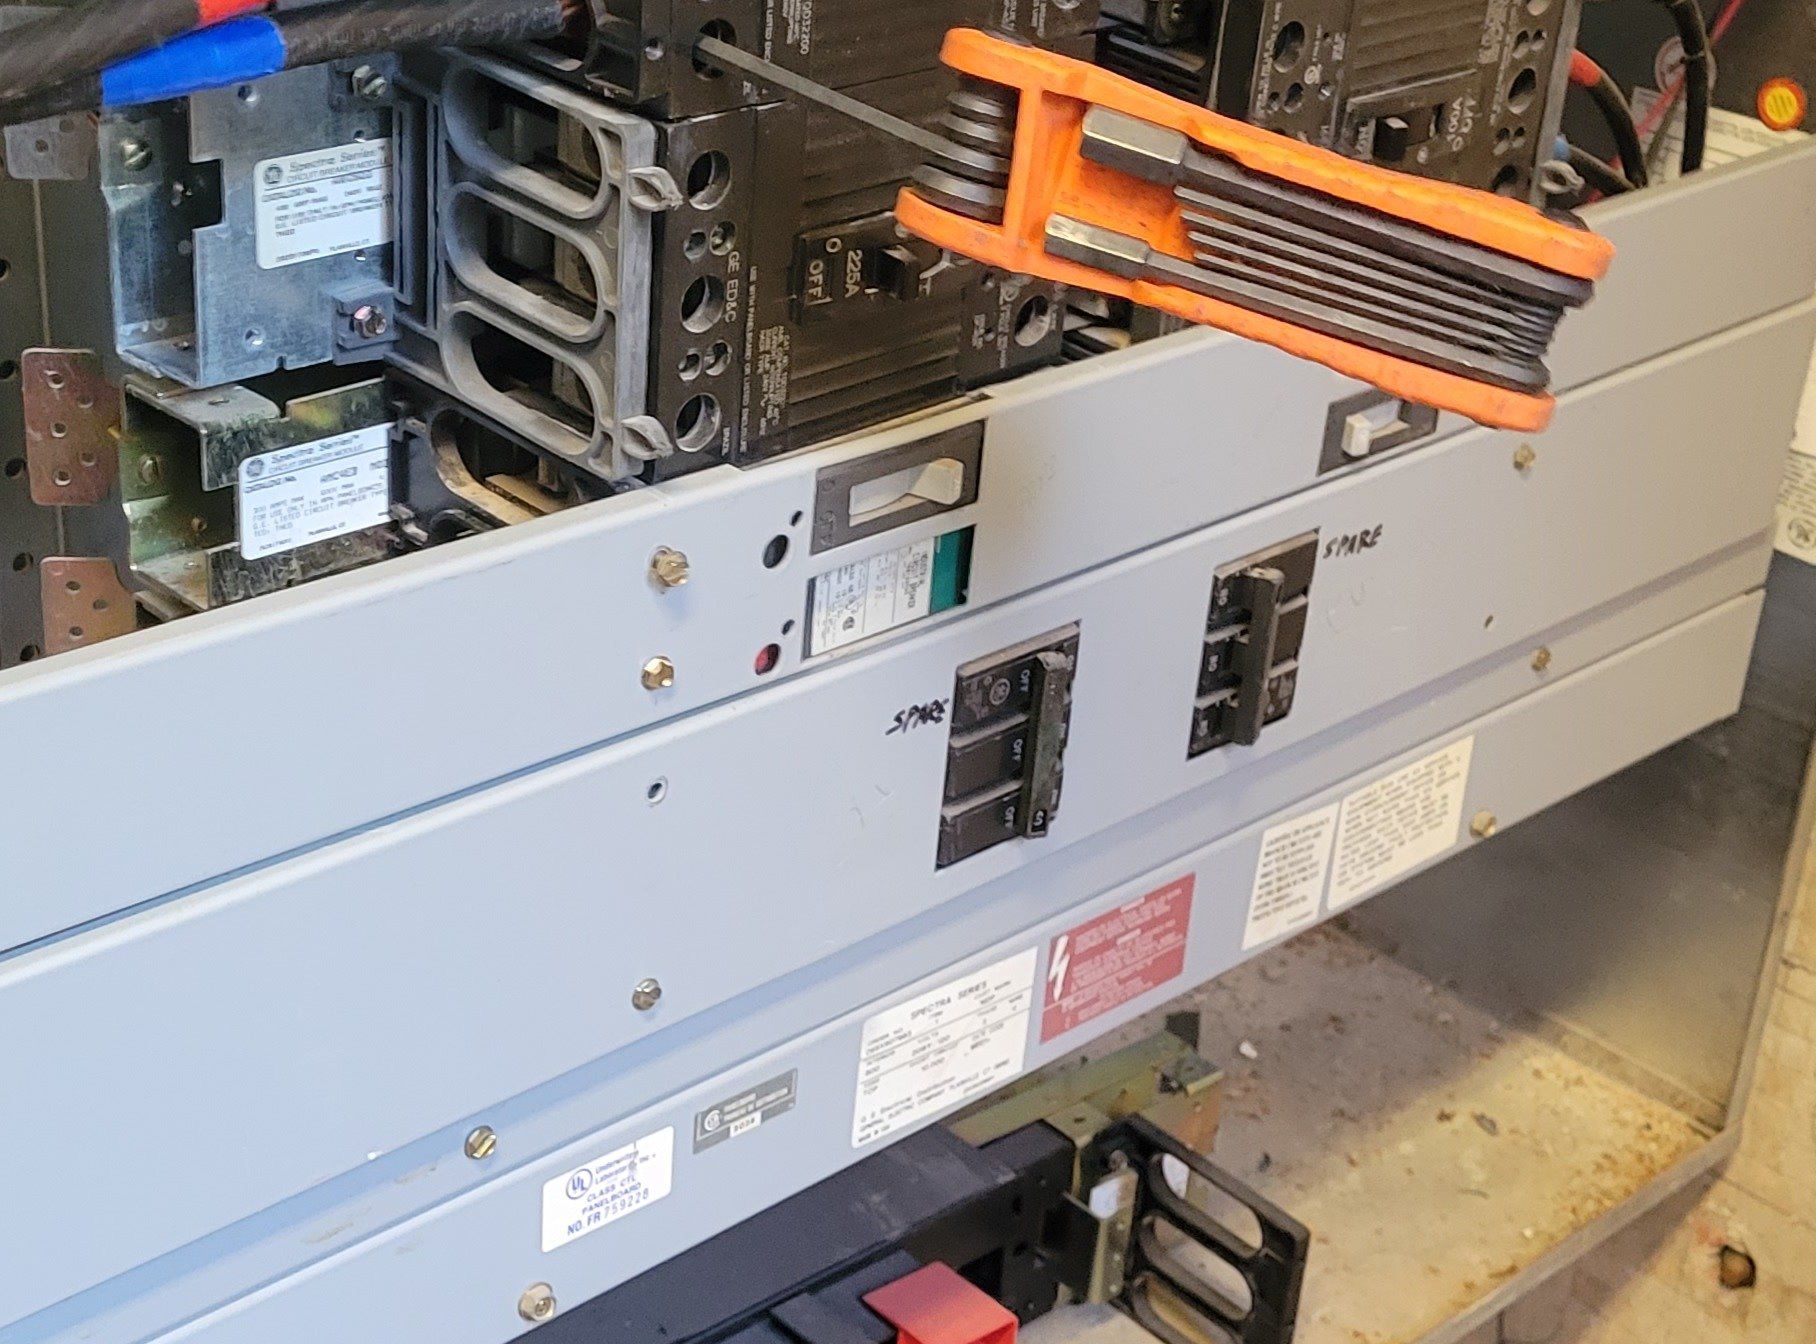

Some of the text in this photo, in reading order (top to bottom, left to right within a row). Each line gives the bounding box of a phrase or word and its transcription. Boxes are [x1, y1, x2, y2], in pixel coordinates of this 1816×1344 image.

[724, 251, 740, 324] GE ED&C
[808, 259, 824, 298] OFF
[844, 249, 863, 298] 225A
[1322, 524, 1384, 560] SPARE
[909, 996, 952, 1021] SPECTRA
[957, 980, 988, 1000] SERIES
[571, 1175, 590, 1192] UL
[582, 1181, 642, 1215] PANELBOARD
[587, 1184, 616, 1203] CLASS
